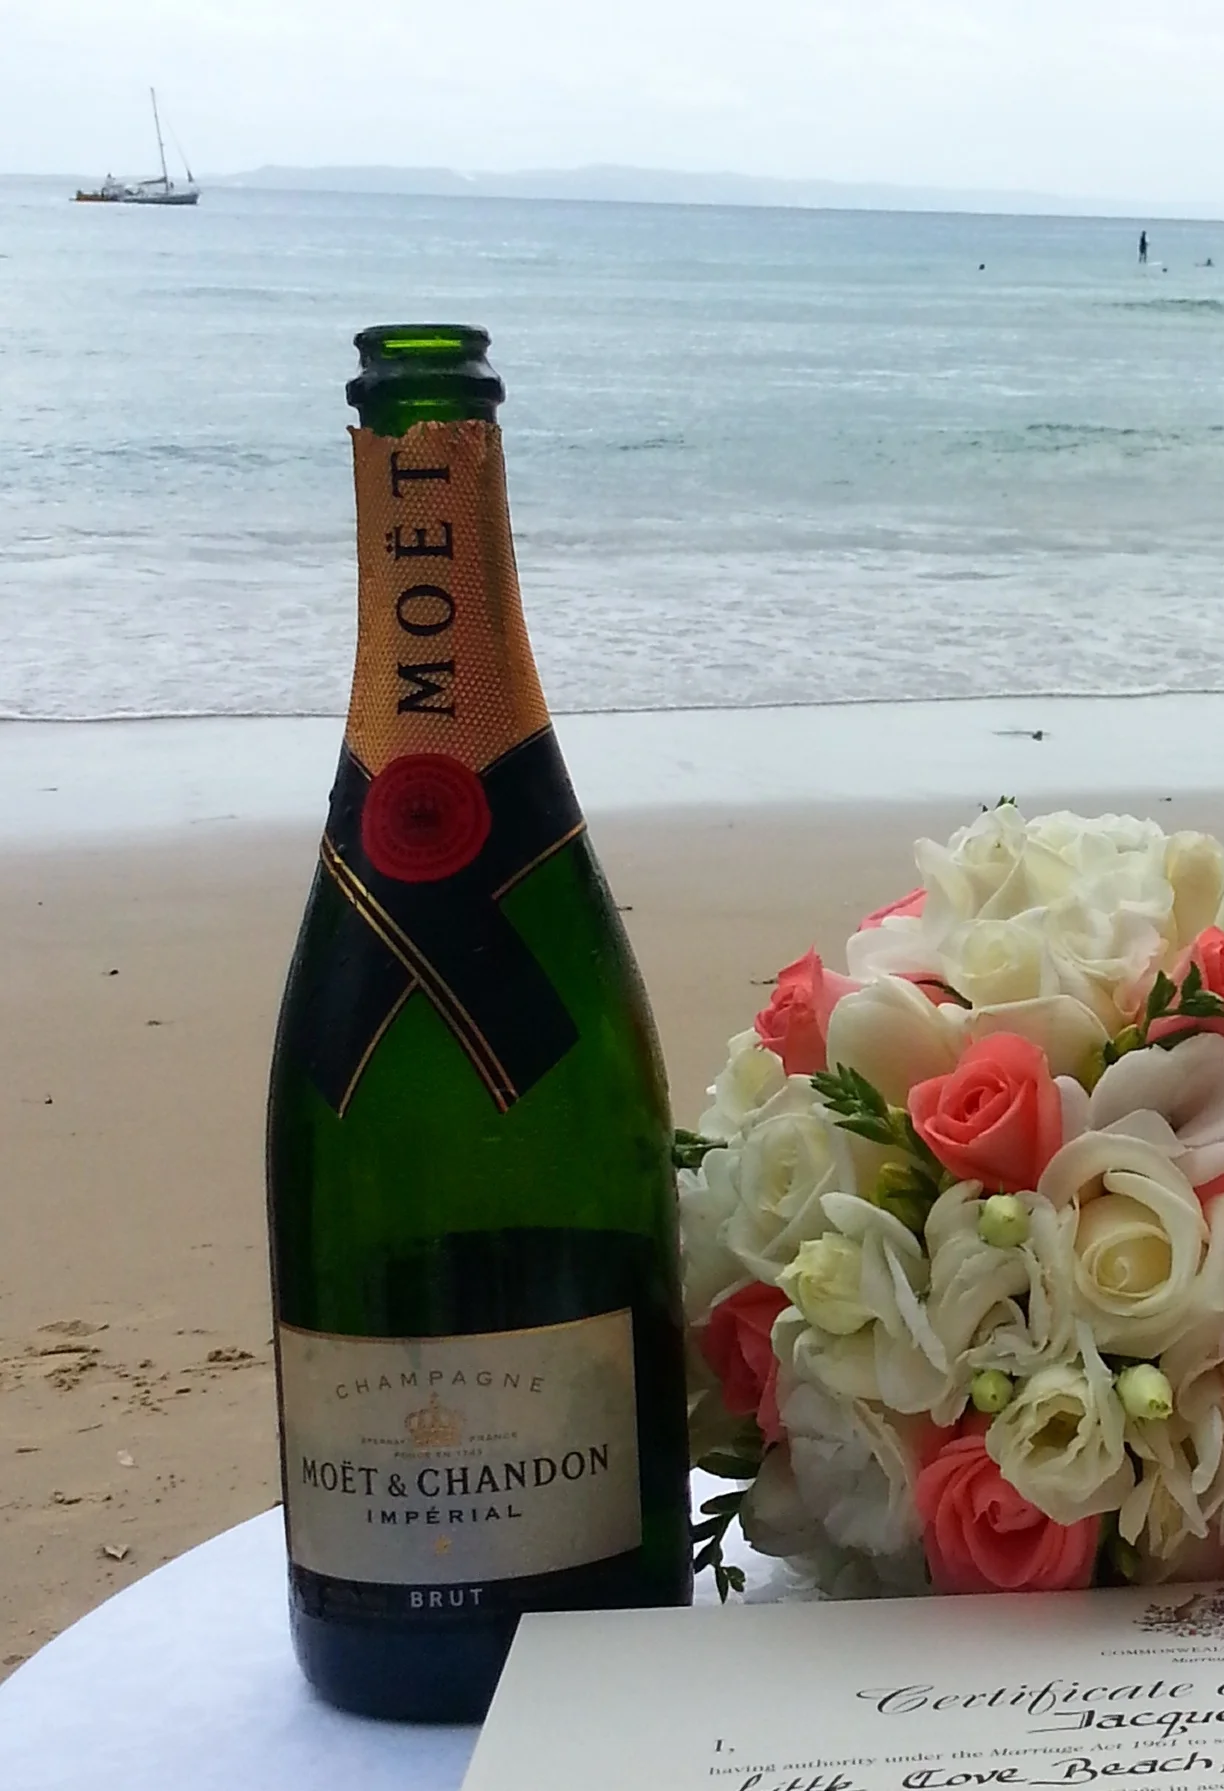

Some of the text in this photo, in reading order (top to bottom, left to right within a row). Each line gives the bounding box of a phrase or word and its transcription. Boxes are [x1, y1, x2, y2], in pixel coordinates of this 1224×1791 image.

[386, 450, 456, 719] MOËT
[335, 1370, 546, 1400] CHAMPAGNE
[468, 1431, 518, 1443] FRANCE
[302, 1443, 610, 1498] MOËT & CHANDON
[367, 1504, 523, 1526] IMPÉRIAL
[410, 1587, 485, 1608] BRUT
[856, 1679, 1194, 1715] Certificate
[708, 1763, 776, 1777] having
[783, 1756, 877, 1772] authority
[885, 1752, 945, 1764] under
[952, 1750, 983, 1761] the
[990, 1744, 1083, 1757] Marriage
[1090, 1741, 1122, 1752] Act
[1133, 1738, 1177, 1749] 1961
[1188, 1738, 1206, 1747] to
[715, 1739, 734, 1753] I,
[902, 1766, 1028, 1789] Cove
